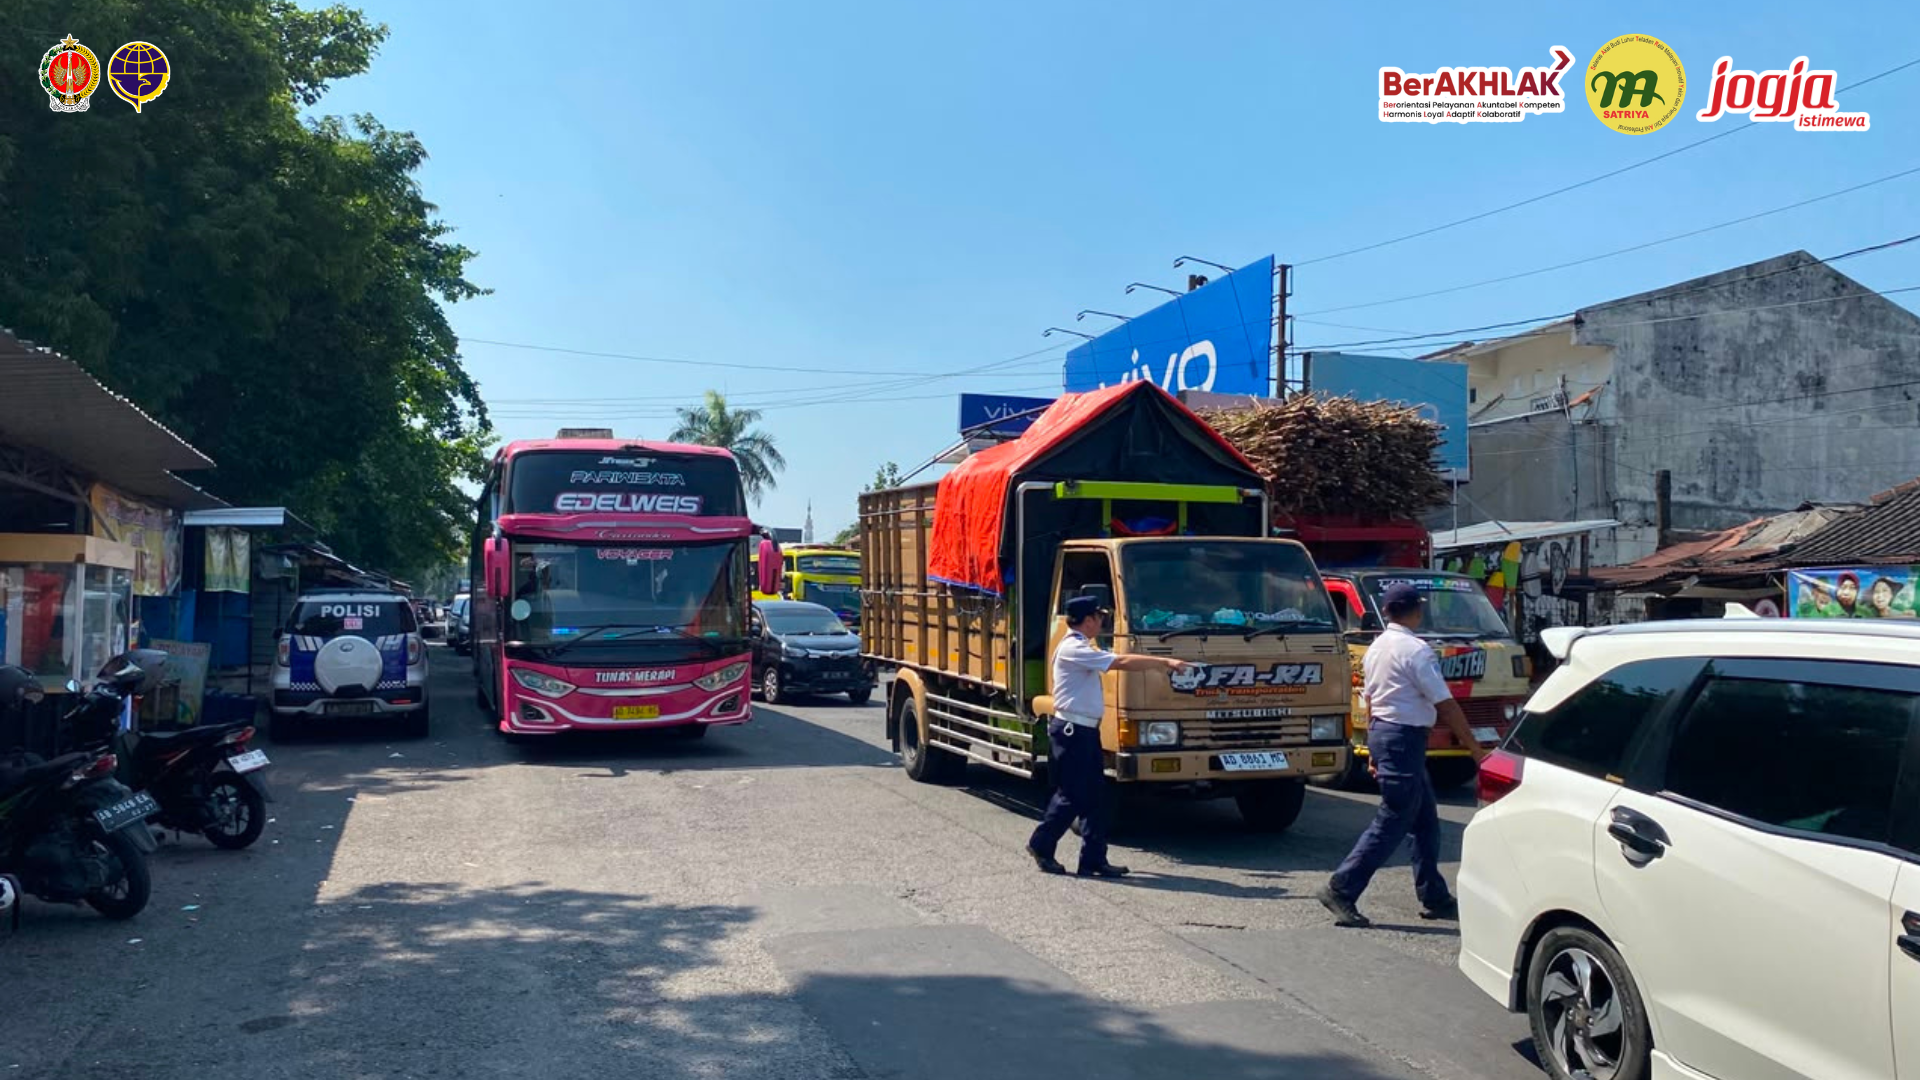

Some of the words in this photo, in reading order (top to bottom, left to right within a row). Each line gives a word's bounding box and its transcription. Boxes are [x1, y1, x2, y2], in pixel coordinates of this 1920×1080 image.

[569, 470, 686, 486] PARIWISATA
[555, 493, 700, 513] EDELWEIS
[320, 604, 380, 618] POLISI
[595, 671, 632, 683] TUNAS
[634, 669, 676, 682] MERAPI
